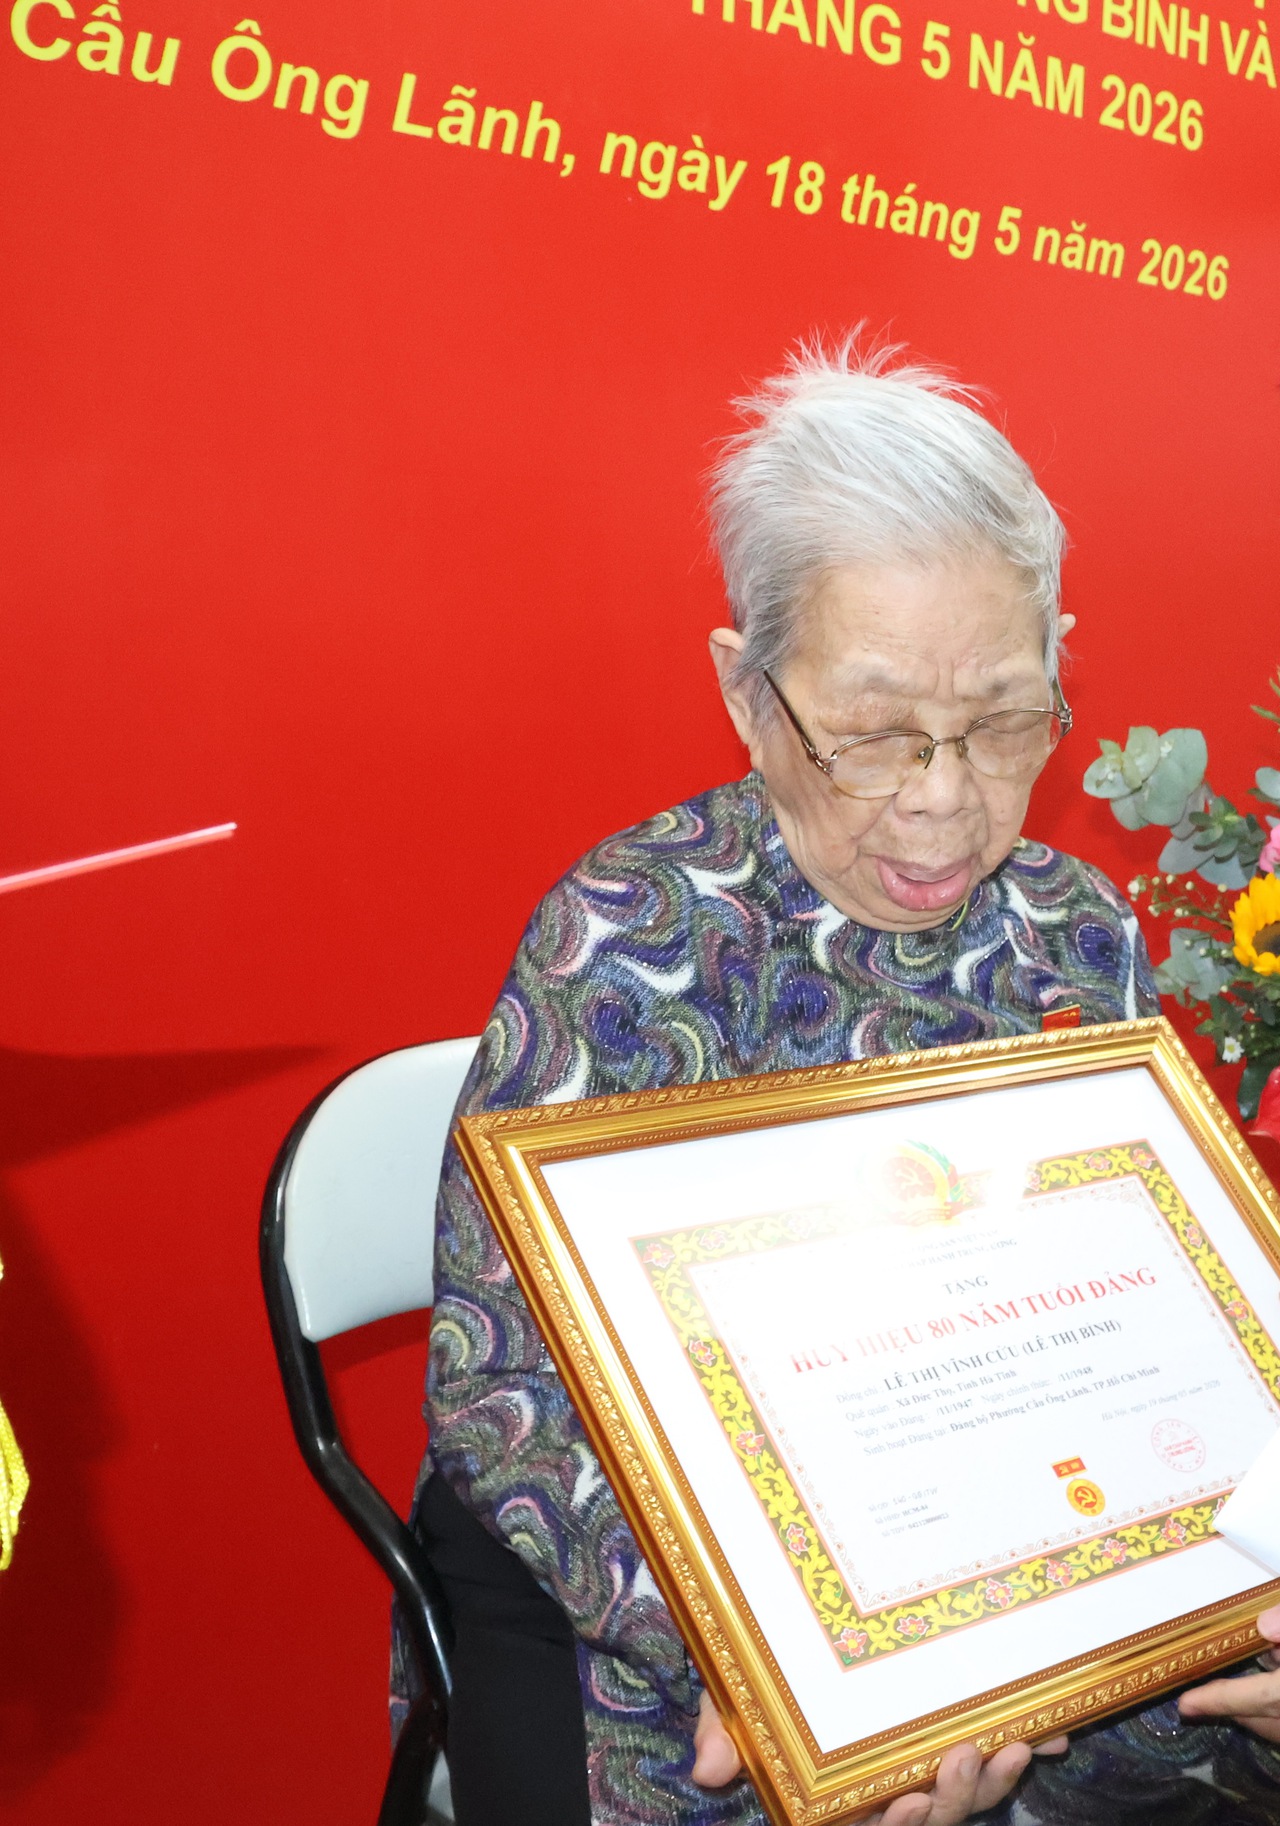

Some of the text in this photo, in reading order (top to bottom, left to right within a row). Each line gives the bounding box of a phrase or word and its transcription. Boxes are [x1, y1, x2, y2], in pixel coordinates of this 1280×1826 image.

[921, 21, 950, 79] 5
[969, 32, 1084, 118] NĂM
[1100, 75, 1203, 150] 2026
[1220, 20, 1276, 88] VÀ
[11, 0, 1230, 300] Cầu Ông Lãnh, ngày 18 tháng 5 năm 2026
[789, 1267, 1157, 1373] HUY HIỆU 80 NĂM TUỔI ĐẢNG
[884, 1371, 907, 1391] LÊ
[908, 1366, 941, 1383] THỊ
[940, 1354, 983, 1374] VĨNH
[1022, 1335, 1049, 1357] (LÊ
[1049, 1329, 1079, 1348] THỊ
[1137, 1365, 1160, 1379] Minh
